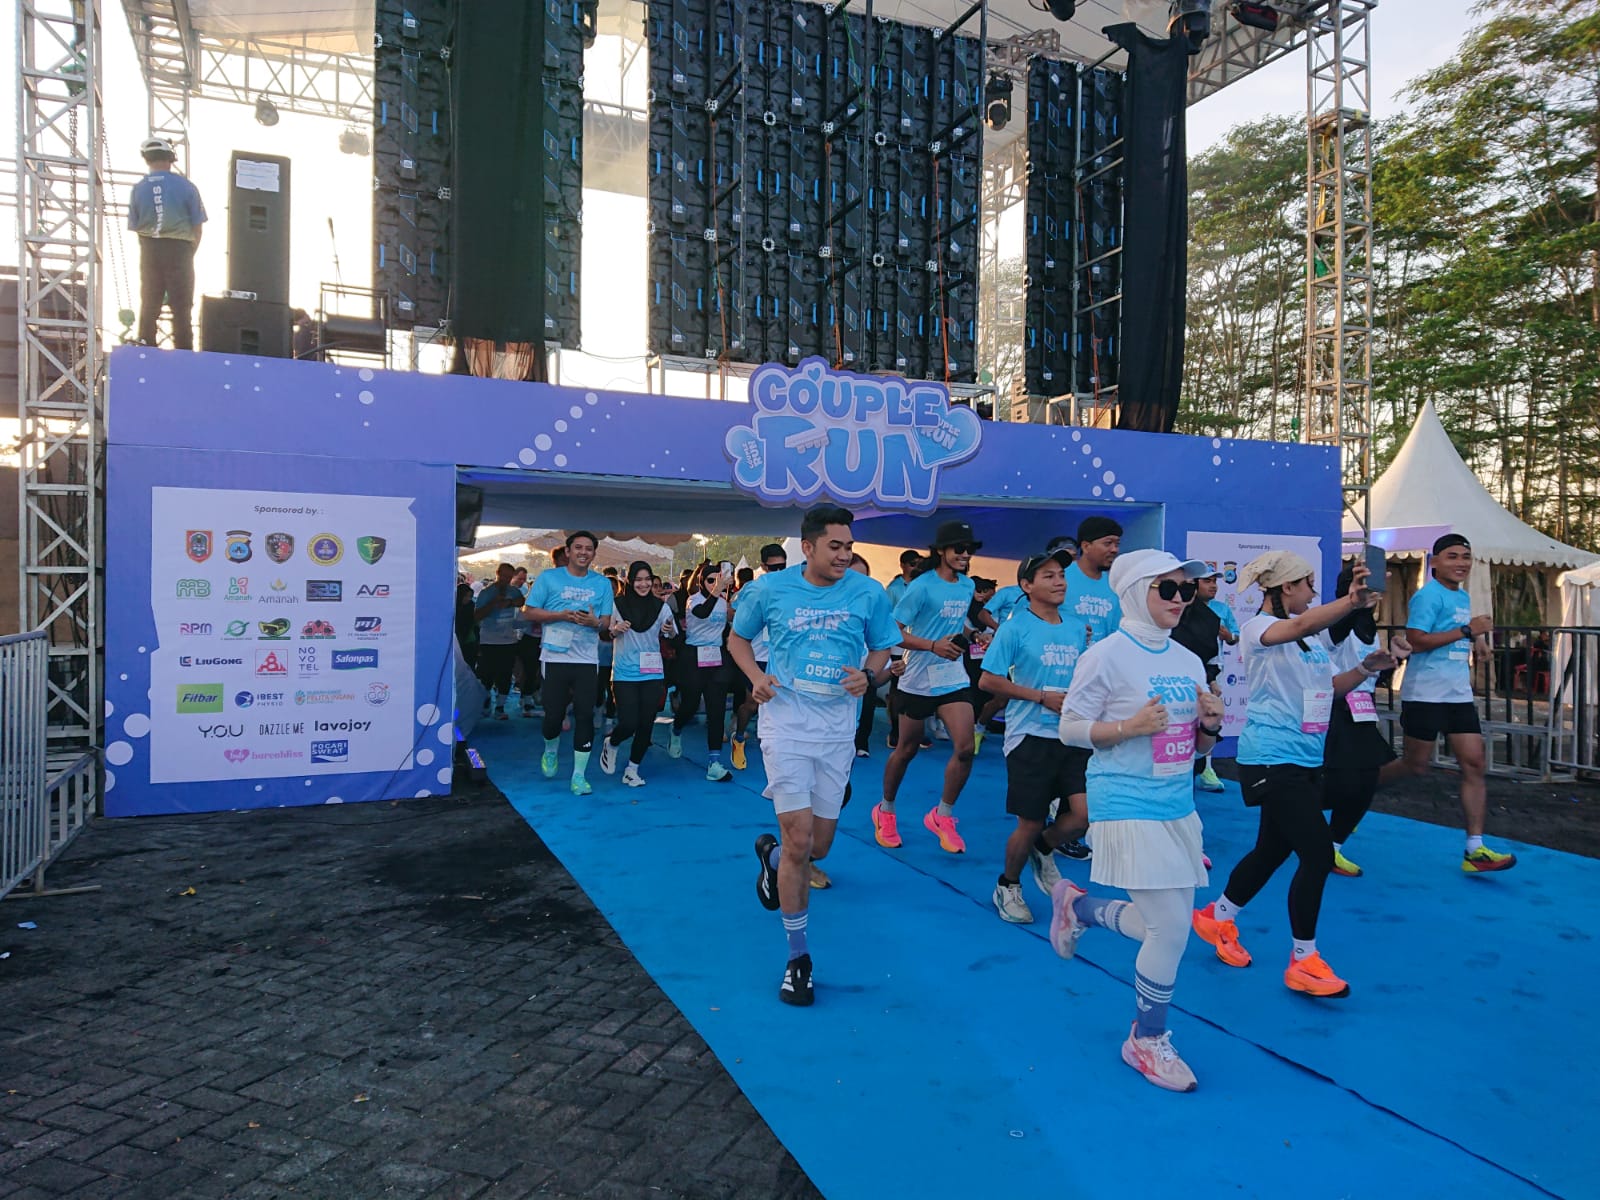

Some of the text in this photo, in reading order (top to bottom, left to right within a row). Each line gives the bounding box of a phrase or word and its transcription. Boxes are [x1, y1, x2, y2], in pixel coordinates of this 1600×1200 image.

[758, 374, 941, 427] COUPLE
[758, 416, 938, 500] RUN
[254, 505, 303, 515] Sponsored
[258, 594, 299, 604] Amanah
[180, 623, 212, 635] RPM
[795, 615, 840, 632] RUN
[336, 654, 375, 665] Salonpas
[804, 663, 841, 679] 05210
[182, 693, 218, 703] Fitbar
[257, 692, 284, 701] IBEST
[1153, 685, 1198, 705] RUN
[198, 724, 243, 738] Y.O.U
[259, 722, 304, 736] DAZZLE ME
[314, 719, 371, 732] lavojoy
[312, 742, 347, 750] POCARI
[312, 747, 344, 755] SWEAT
